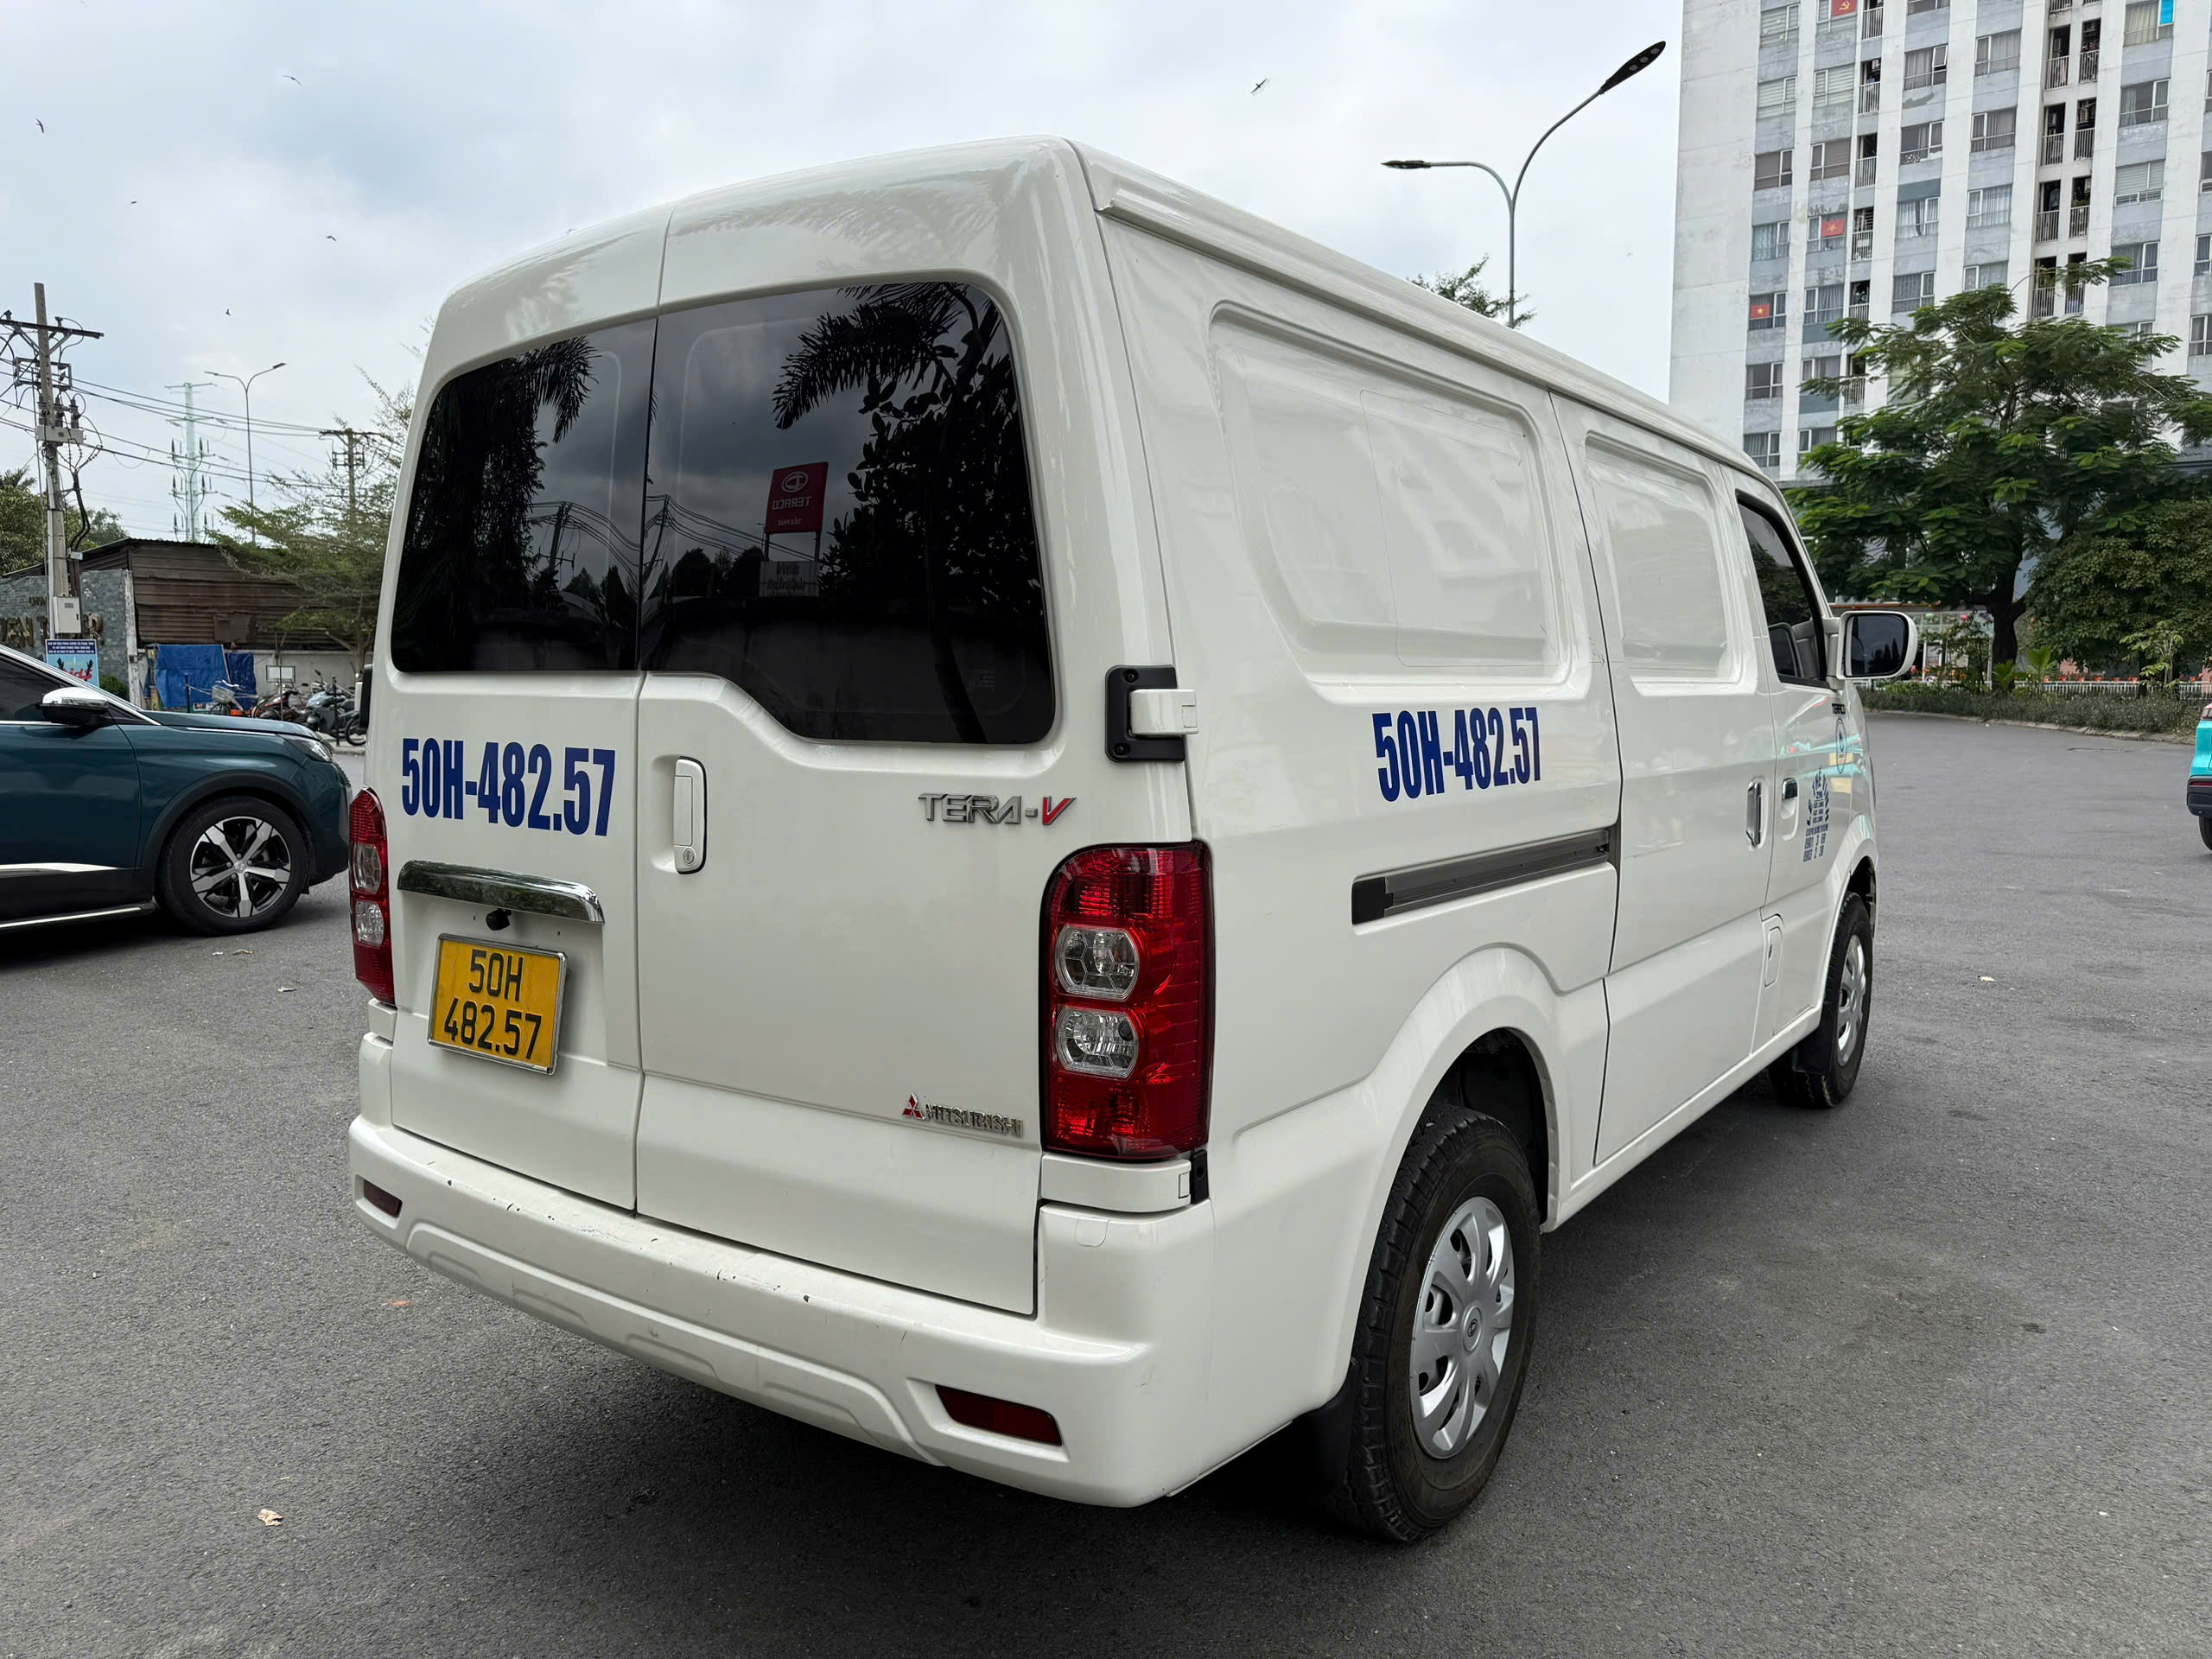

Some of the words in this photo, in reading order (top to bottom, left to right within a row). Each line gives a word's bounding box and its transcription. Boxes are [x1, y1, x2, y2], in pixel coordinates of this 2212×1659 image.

[1372, 707, 1541, 802] 50H-482.57
[402, 737, 616, 836] 50H-482.57
[918, 792, 1077, 825] TERA-V
[468, 949, 524, 1002] 50H
[443, 997, 542, 1059] 482.57
[925, 1103, 1024, 1137] MITSUBISHI
